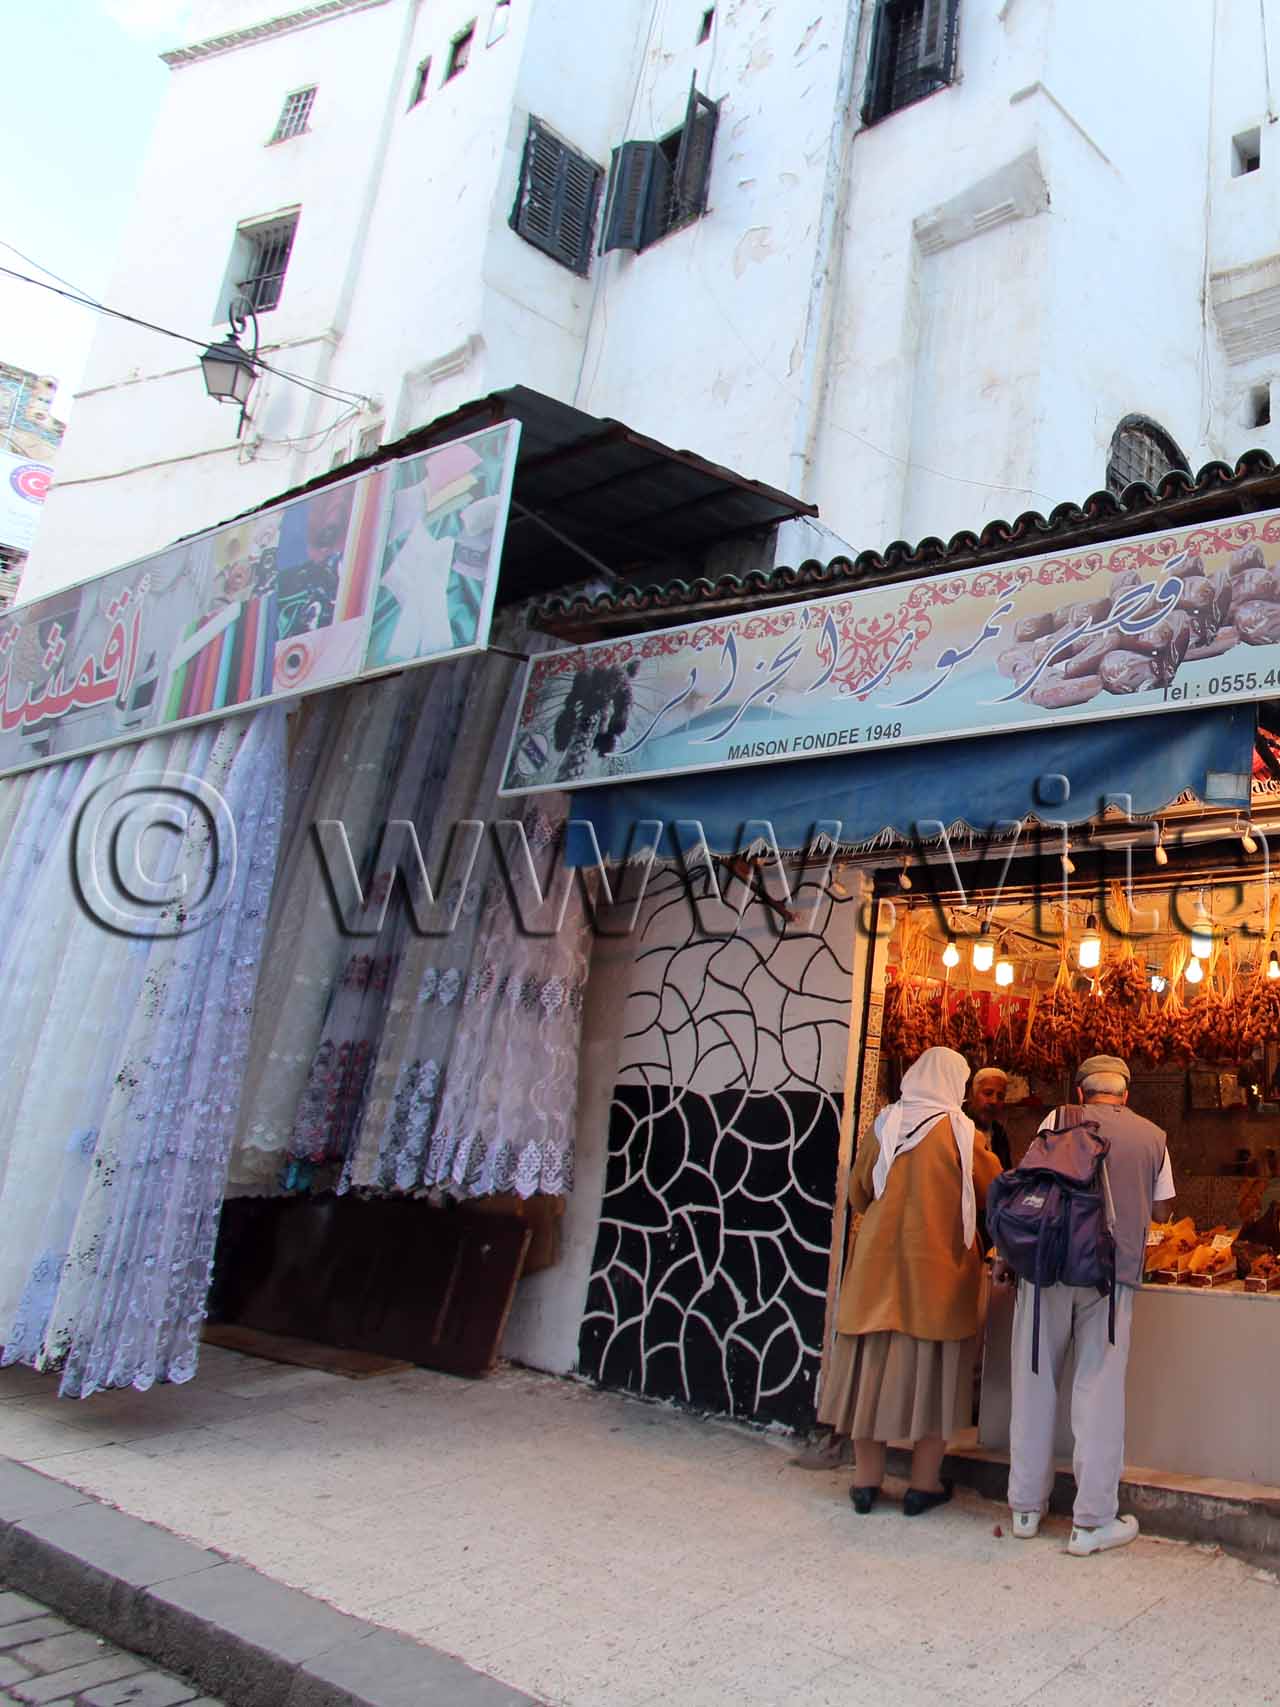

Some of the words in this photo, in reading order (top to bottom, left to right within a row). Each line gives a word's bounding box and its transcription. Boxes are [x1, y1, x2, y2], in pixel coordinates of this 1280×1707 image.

[1163, 684, 1189, 702] Tel
[727, 740, 790, 760] MAISON
[792, 728, 860, 751] FONDEE
[865, 722, 903, 741] 1948
